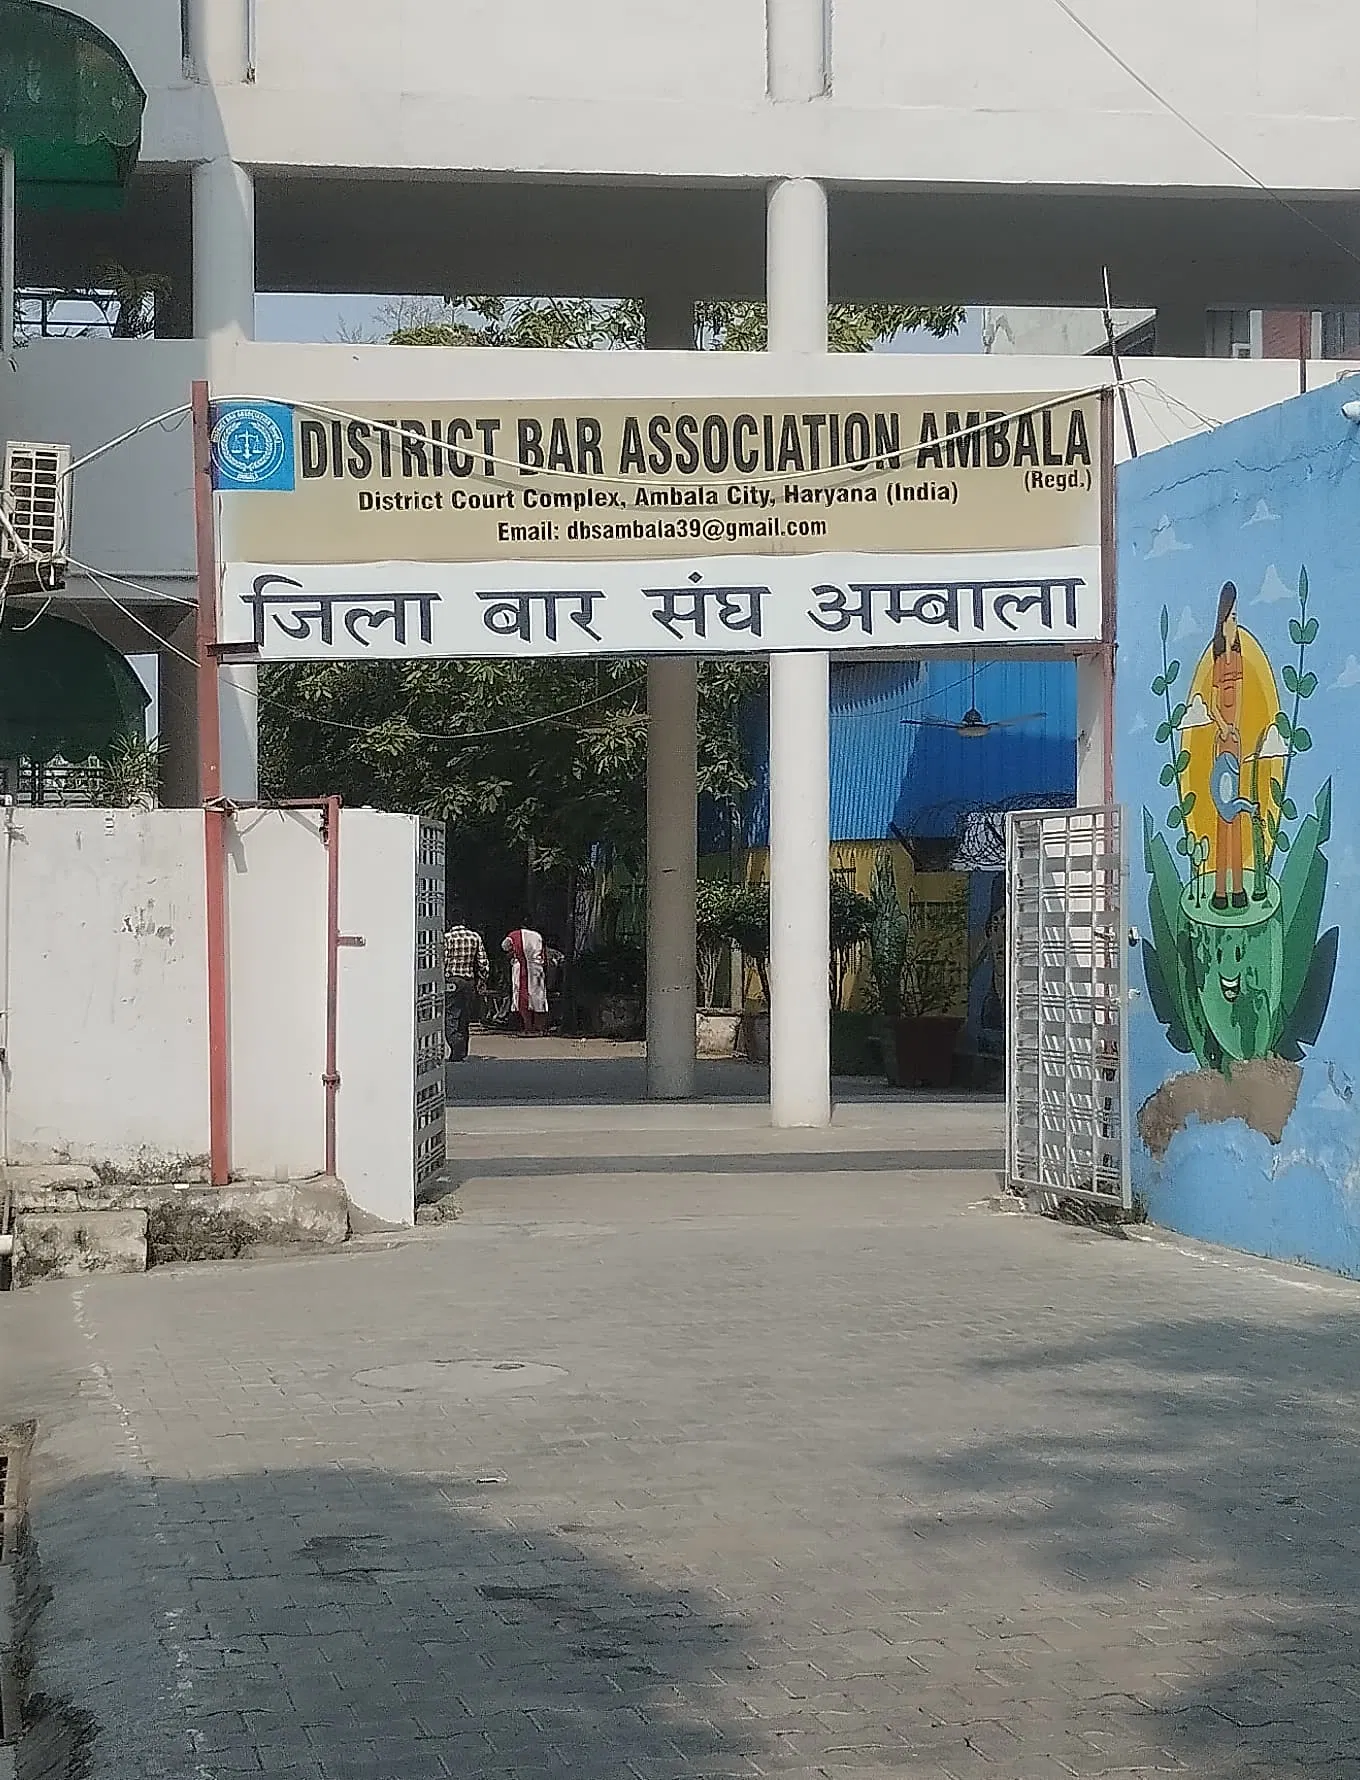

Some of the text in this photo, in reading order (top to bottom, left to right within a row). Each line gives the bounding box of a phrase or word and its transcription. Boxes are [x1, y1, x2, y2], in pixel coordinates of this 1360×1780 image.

[300, 416, 501, 480] DISTRICT
[518, 414, 605, 477] BAR
[618, 411, 901, 476] ASSOCIATION
[916, 409, 1092, 470] AMBALA
[1024, 469, 1092, 492] (Regd.)
[358, 481, 959, 512] District Court Complex, Ambala City, Haryana (India)
[498, 516, 827, 544] Email: dbsambala39@gmail.com
[239, 571, 1086, 647] जिला बार संघ अम्बाला
